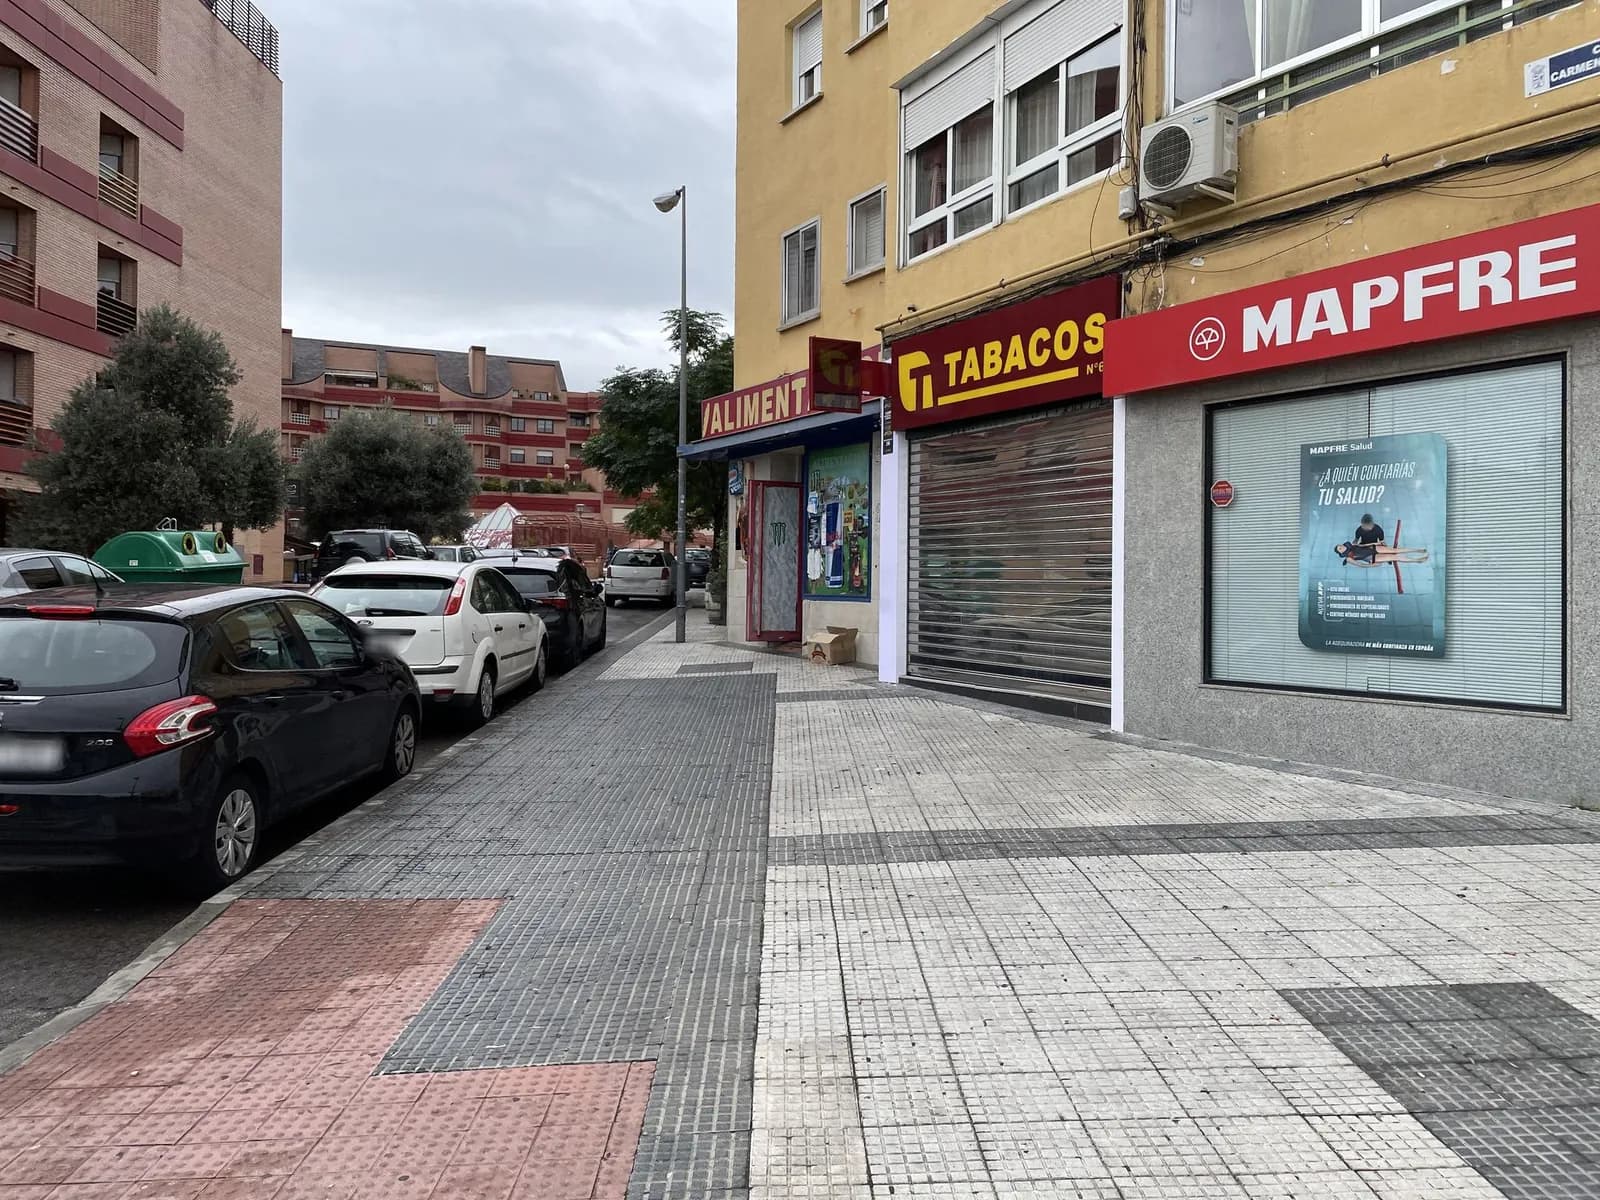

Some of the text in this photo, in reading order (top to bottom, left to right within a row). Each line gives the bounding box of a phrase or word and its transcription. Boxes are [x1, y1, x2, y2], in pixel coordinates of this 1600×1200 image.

[1242, 234, 1577, 353] MAPFRE
[944, 312, 1107, 387] TABACOS
[710, 376, 810, 436] ALIMENT
[1310, 441, 1373, 455] MAPFRE Salud
[1332, 464, 1359, 485] QUIÉN
[1360, 460, 1415, 480] CONFIARÍAS
[1318, 486, 1385, 506] TU SALUD?
